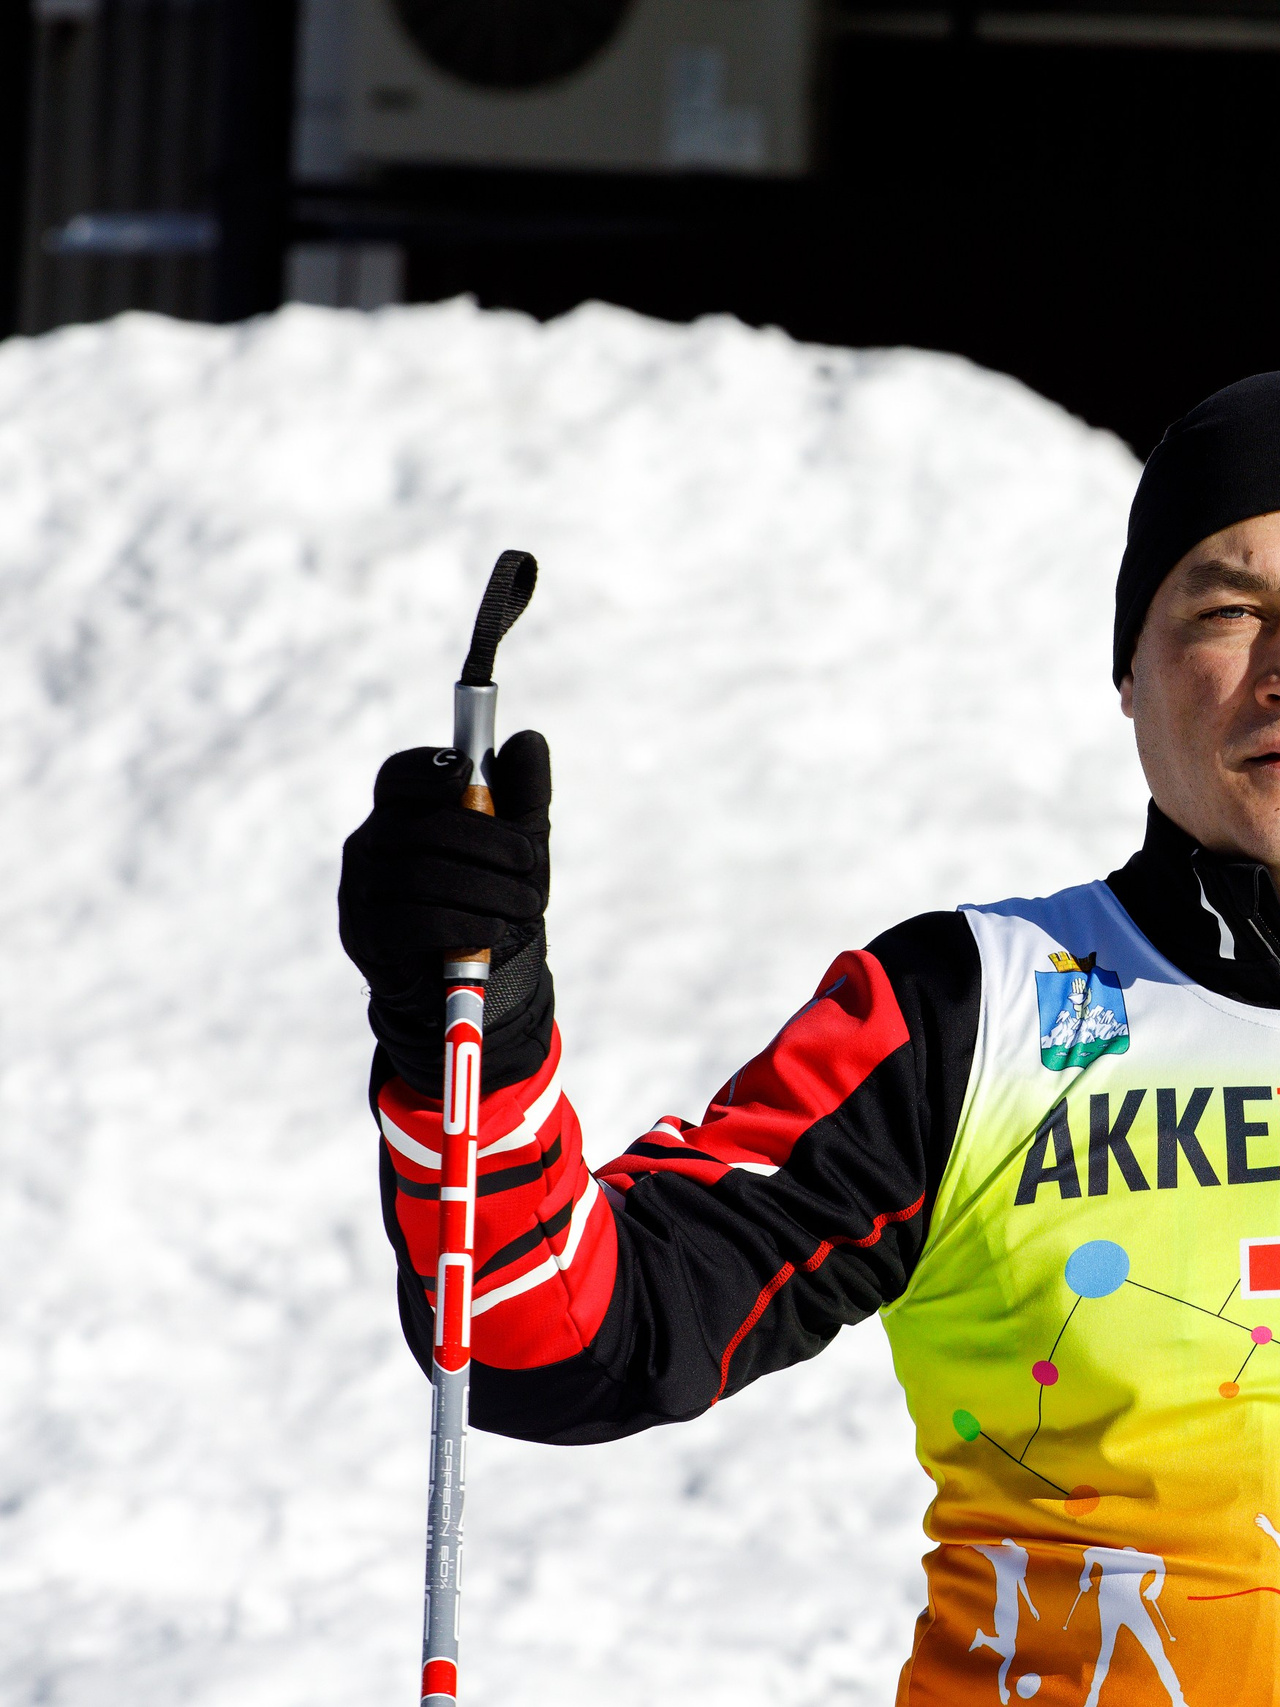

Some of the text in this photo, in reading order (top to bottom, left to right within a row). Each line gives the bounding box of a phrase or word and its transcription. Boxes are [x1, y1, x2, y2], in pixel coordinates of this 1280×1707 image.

[434, 1041, 480, 1348] STC
[439, 1439, 453, 1589] CARBON 60%
